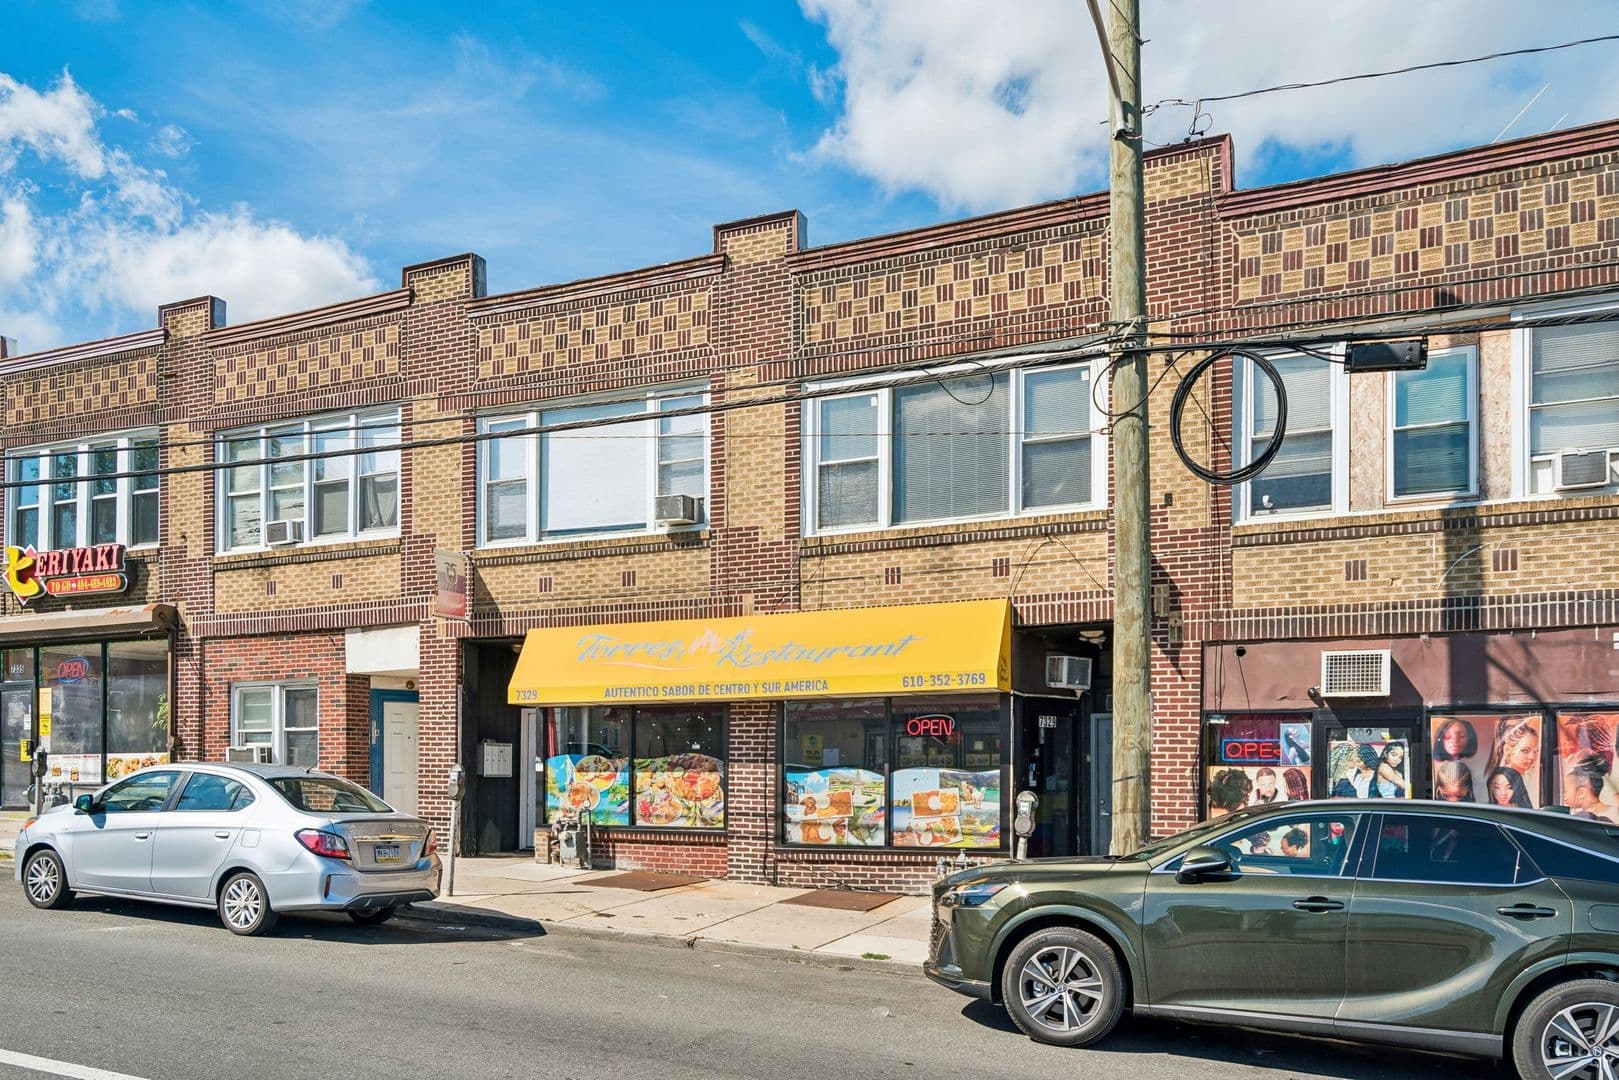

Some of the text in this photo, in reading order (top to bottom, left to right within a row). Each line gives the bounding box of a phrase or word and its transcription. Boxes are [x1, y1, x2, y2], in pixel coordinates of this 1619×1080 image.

[716, 630, 925, 668] Restaurant
[57, 661, 87, 677] OPEN
[604, 679, 829, 698] AUTENTICO SABOR DE CENTRO Y SUR AMERICA
[902, 672, 986, 688] 610-352-3769
[515, 689, 538, 701] 7329
[906, 718, 954, 736] OPEN
